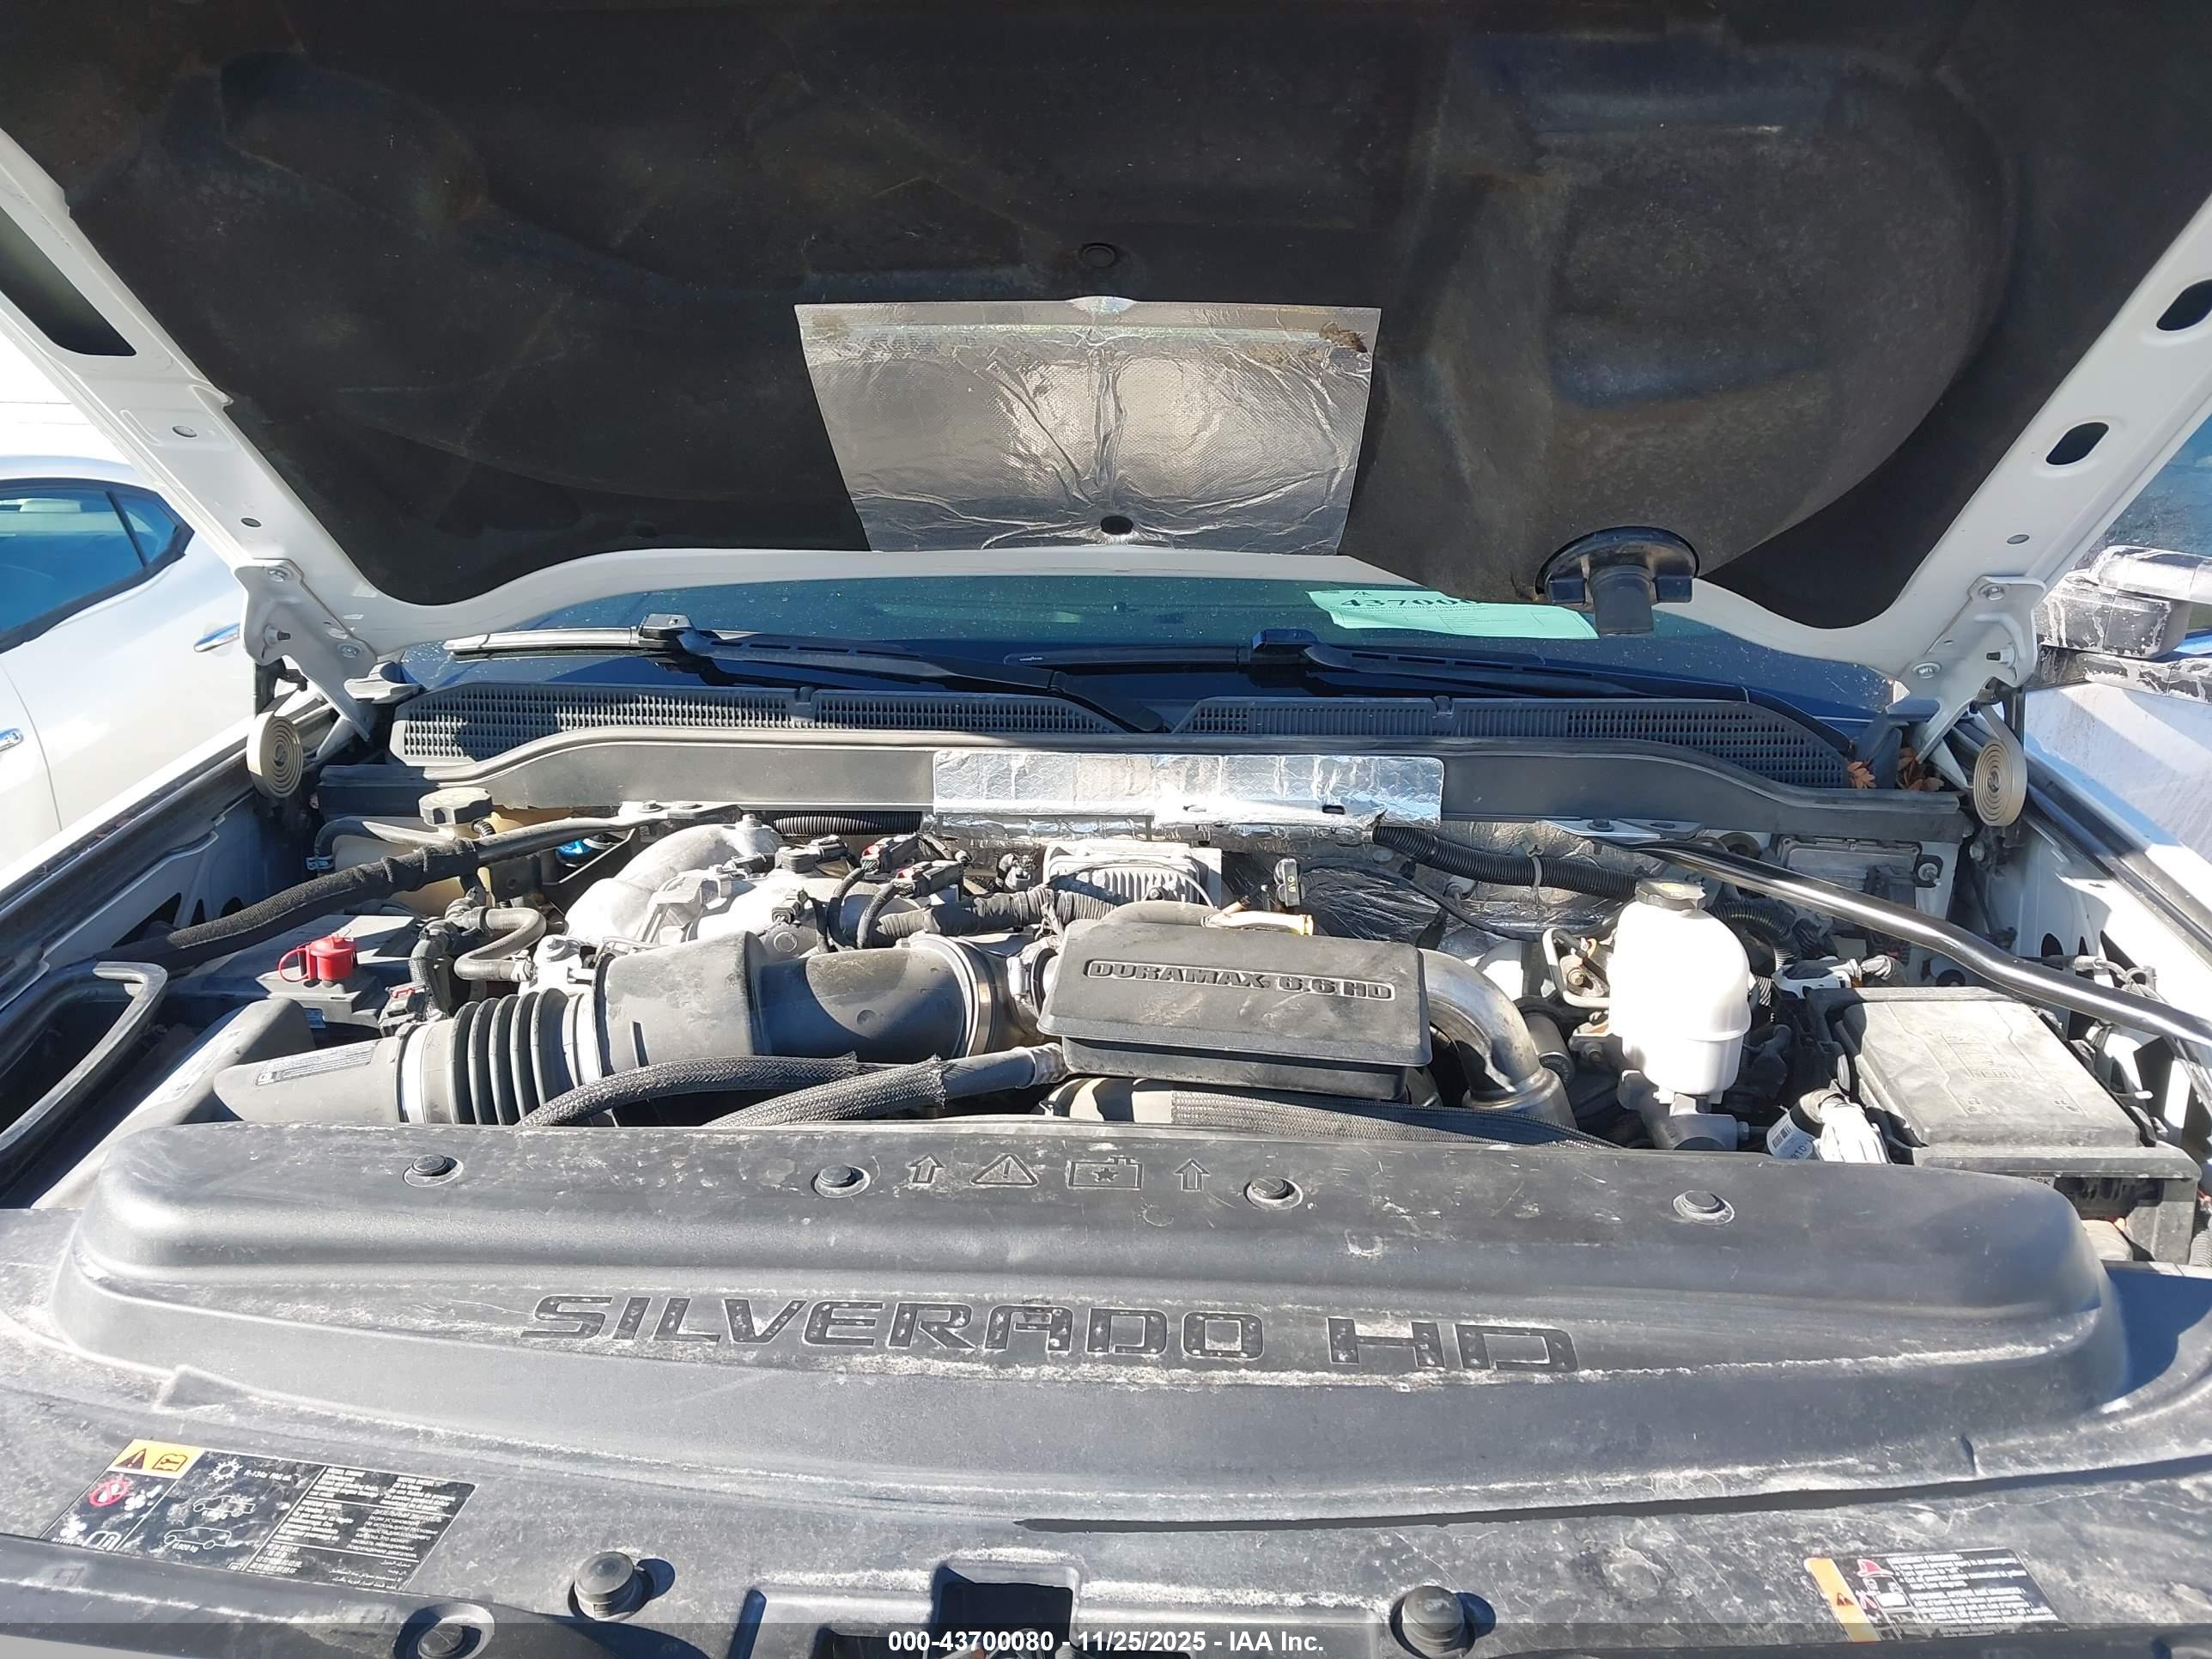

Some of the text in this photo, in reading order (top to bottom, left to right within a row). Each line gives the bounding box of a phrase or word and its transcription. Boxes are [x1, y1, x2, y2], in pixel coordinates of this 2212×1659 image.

[1089, 962, 1395, 1001] DURAMAX 6.6 HD
[521, 1295, 1579, 1373] SILVERADO HD
